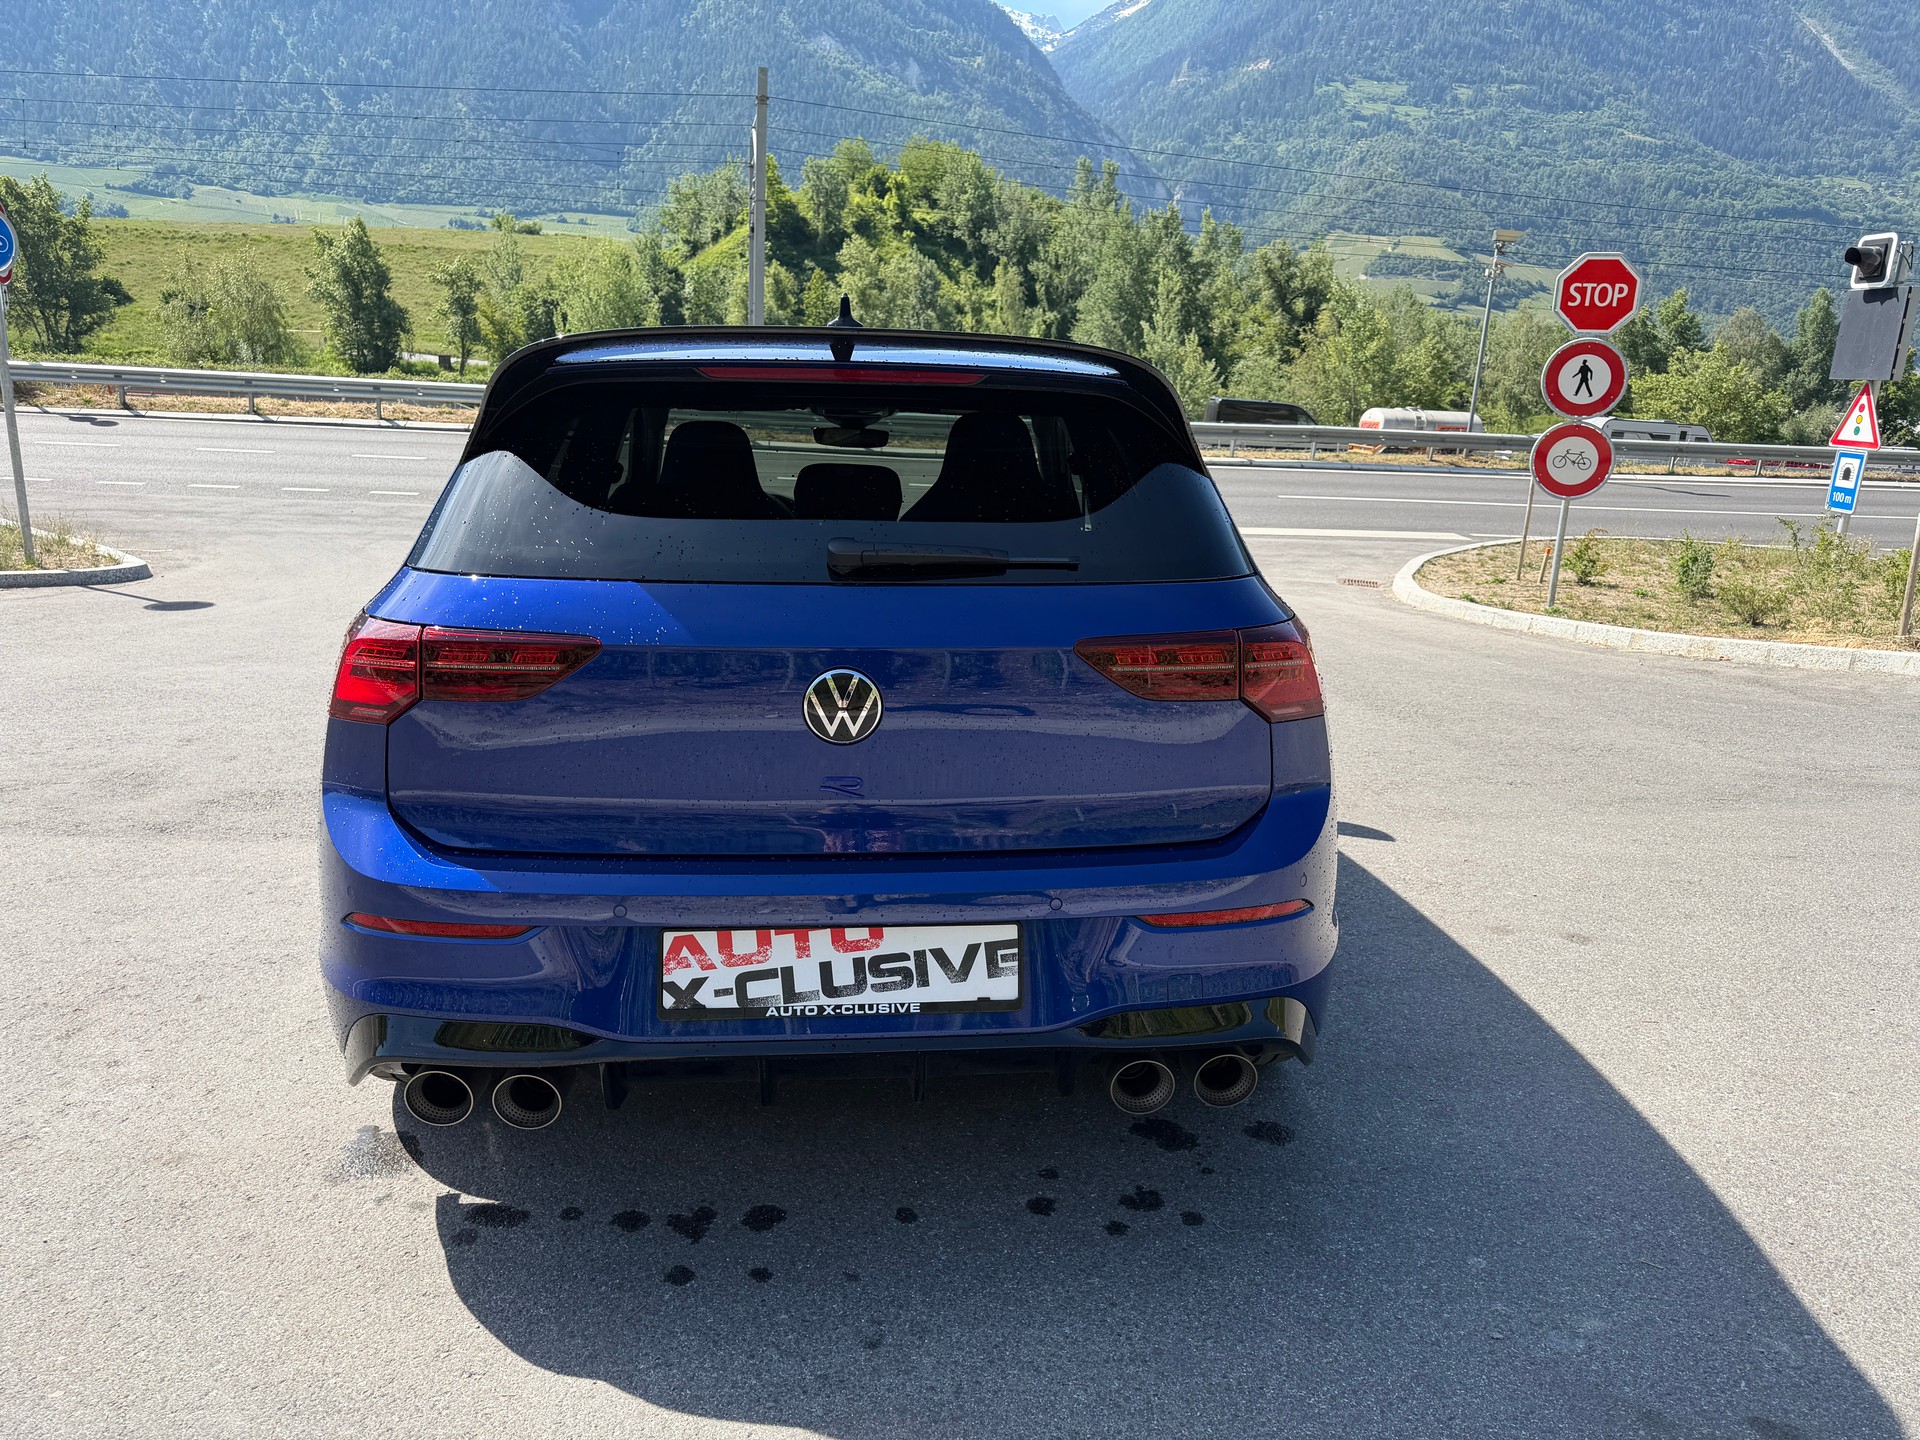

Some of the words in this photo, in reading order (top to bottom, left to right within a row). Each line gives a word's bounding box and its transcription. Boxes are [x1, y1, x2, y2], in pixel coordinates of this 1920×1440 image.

[1567, 282, 1628, 307] STOP
[1832, 491, 1845, 503] 100
[1844, 495, 1852, 504] m
[807, 671, 879, 740] VW
[663, 927, 884, 976] AUTO
[663, 938, 1018, 1009] X-CLUSIVE
[765, 1005, 817, 1017] AUTO
[822, 1003, 921, 1015] X-CLUSIVE
